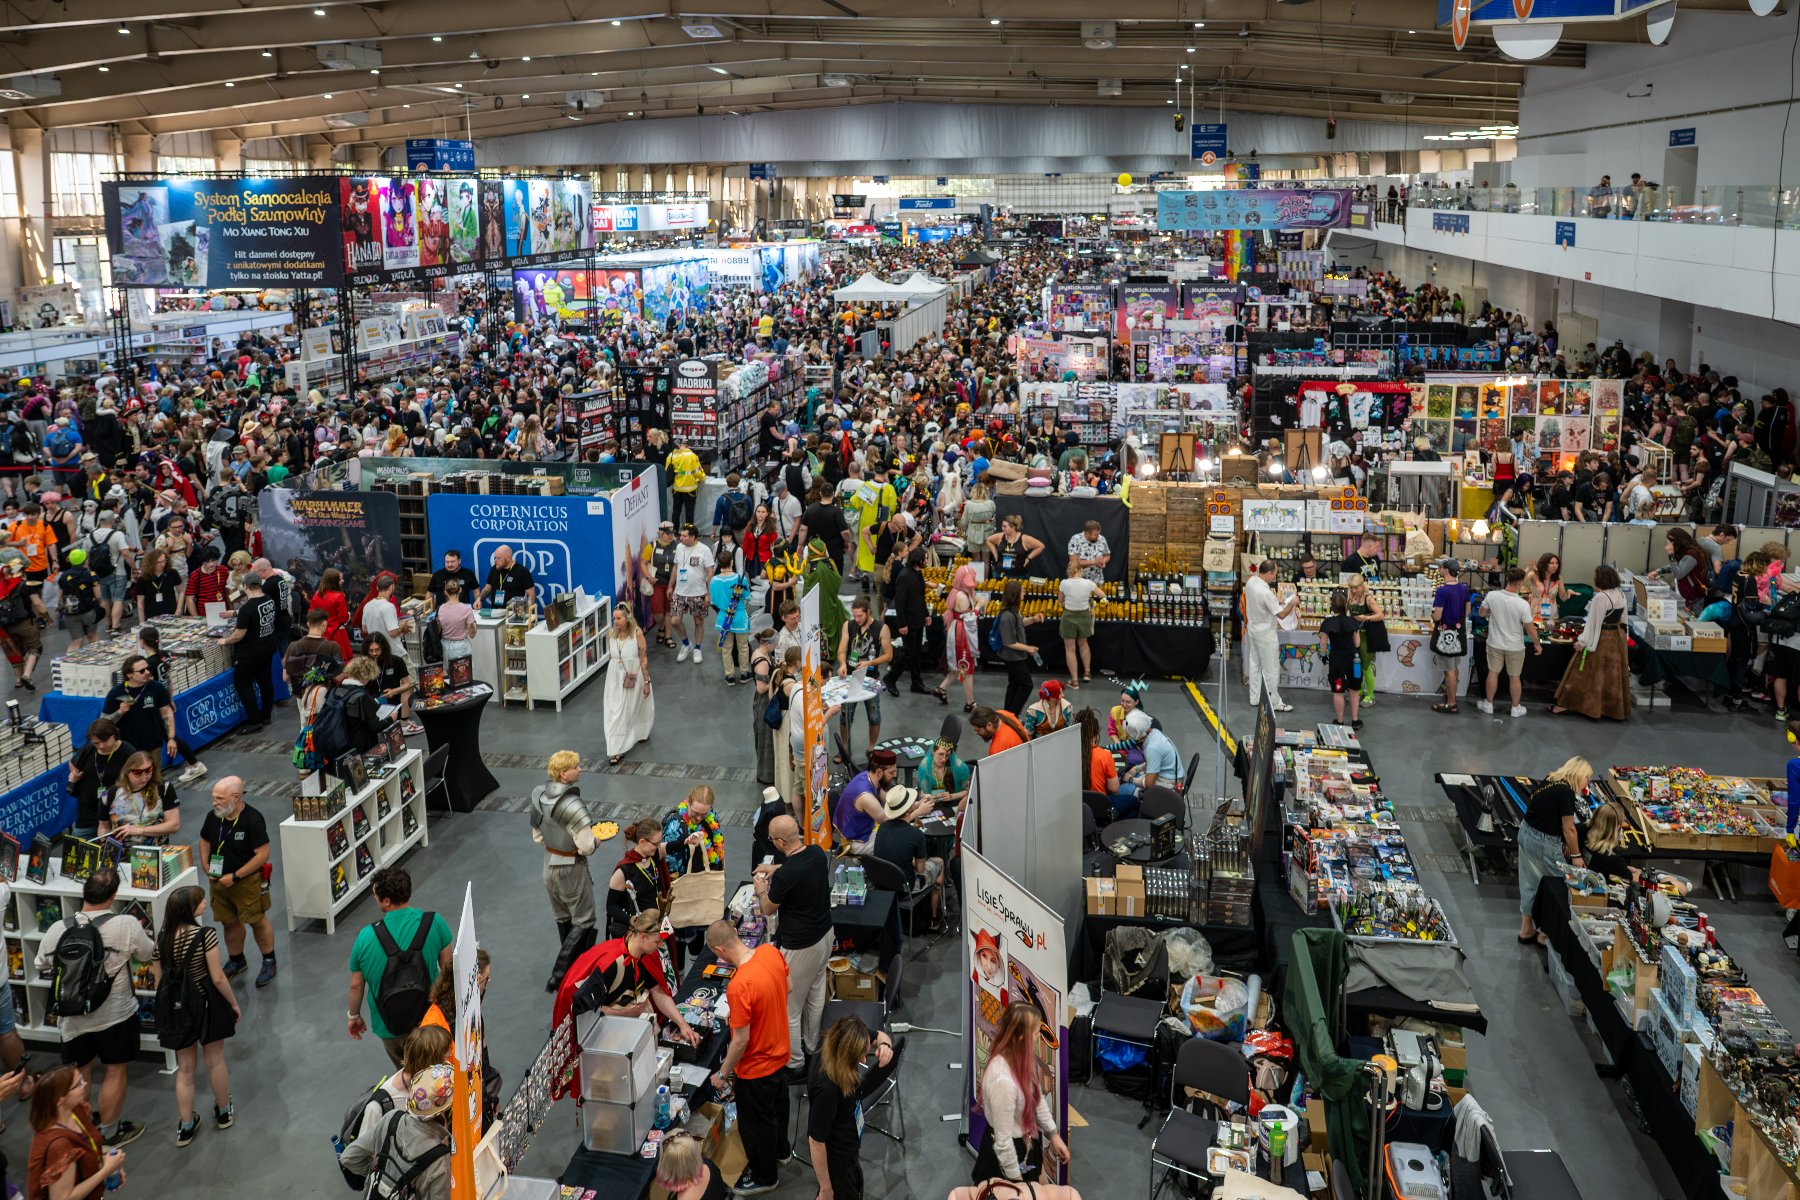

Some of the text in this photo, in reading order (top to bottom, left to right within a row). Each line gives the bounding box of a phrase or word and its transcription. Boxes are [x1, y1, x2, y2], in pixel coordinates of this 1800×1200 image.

[194, 188, 332, 209] System Samoocalenia
[1276, 195, 1306, 208] ART
[208, 206, 326, 225] Podłej Szumowiny
[617, 210, 636, 218] BAN
[1274, 205, 1328, 220] ARCADE
[617, 219, 633, 228] DAI
[234, 250, 315, 260] Hit danmei dostępny
[233, 261, 281, 270] unikatowymi
[284, 261, 325, 269] dodatkami
[230, 272, 249, 281] tylko
[263, 272, 289, 280] stoisku
[1058, 284, 1102, 292] joystick.com.pl
[1192, 286, 1237, 294] joystick.com.pl
[677, 378, 712, 389] NADRUKI
[585, 396, 610, 412] NADRUKI
[292, 500, 364, 514] WARHAMMER
[624, 484, 648, 517] DEFIANT
[470, 504, 568, 519] COPERNICUS
[471, 519, 568, 532] CORPORATION
[192, 701, 210, 717] COP
[190, 710, 215, 730] CORP
[8, 806, 59, 836] ORATION
